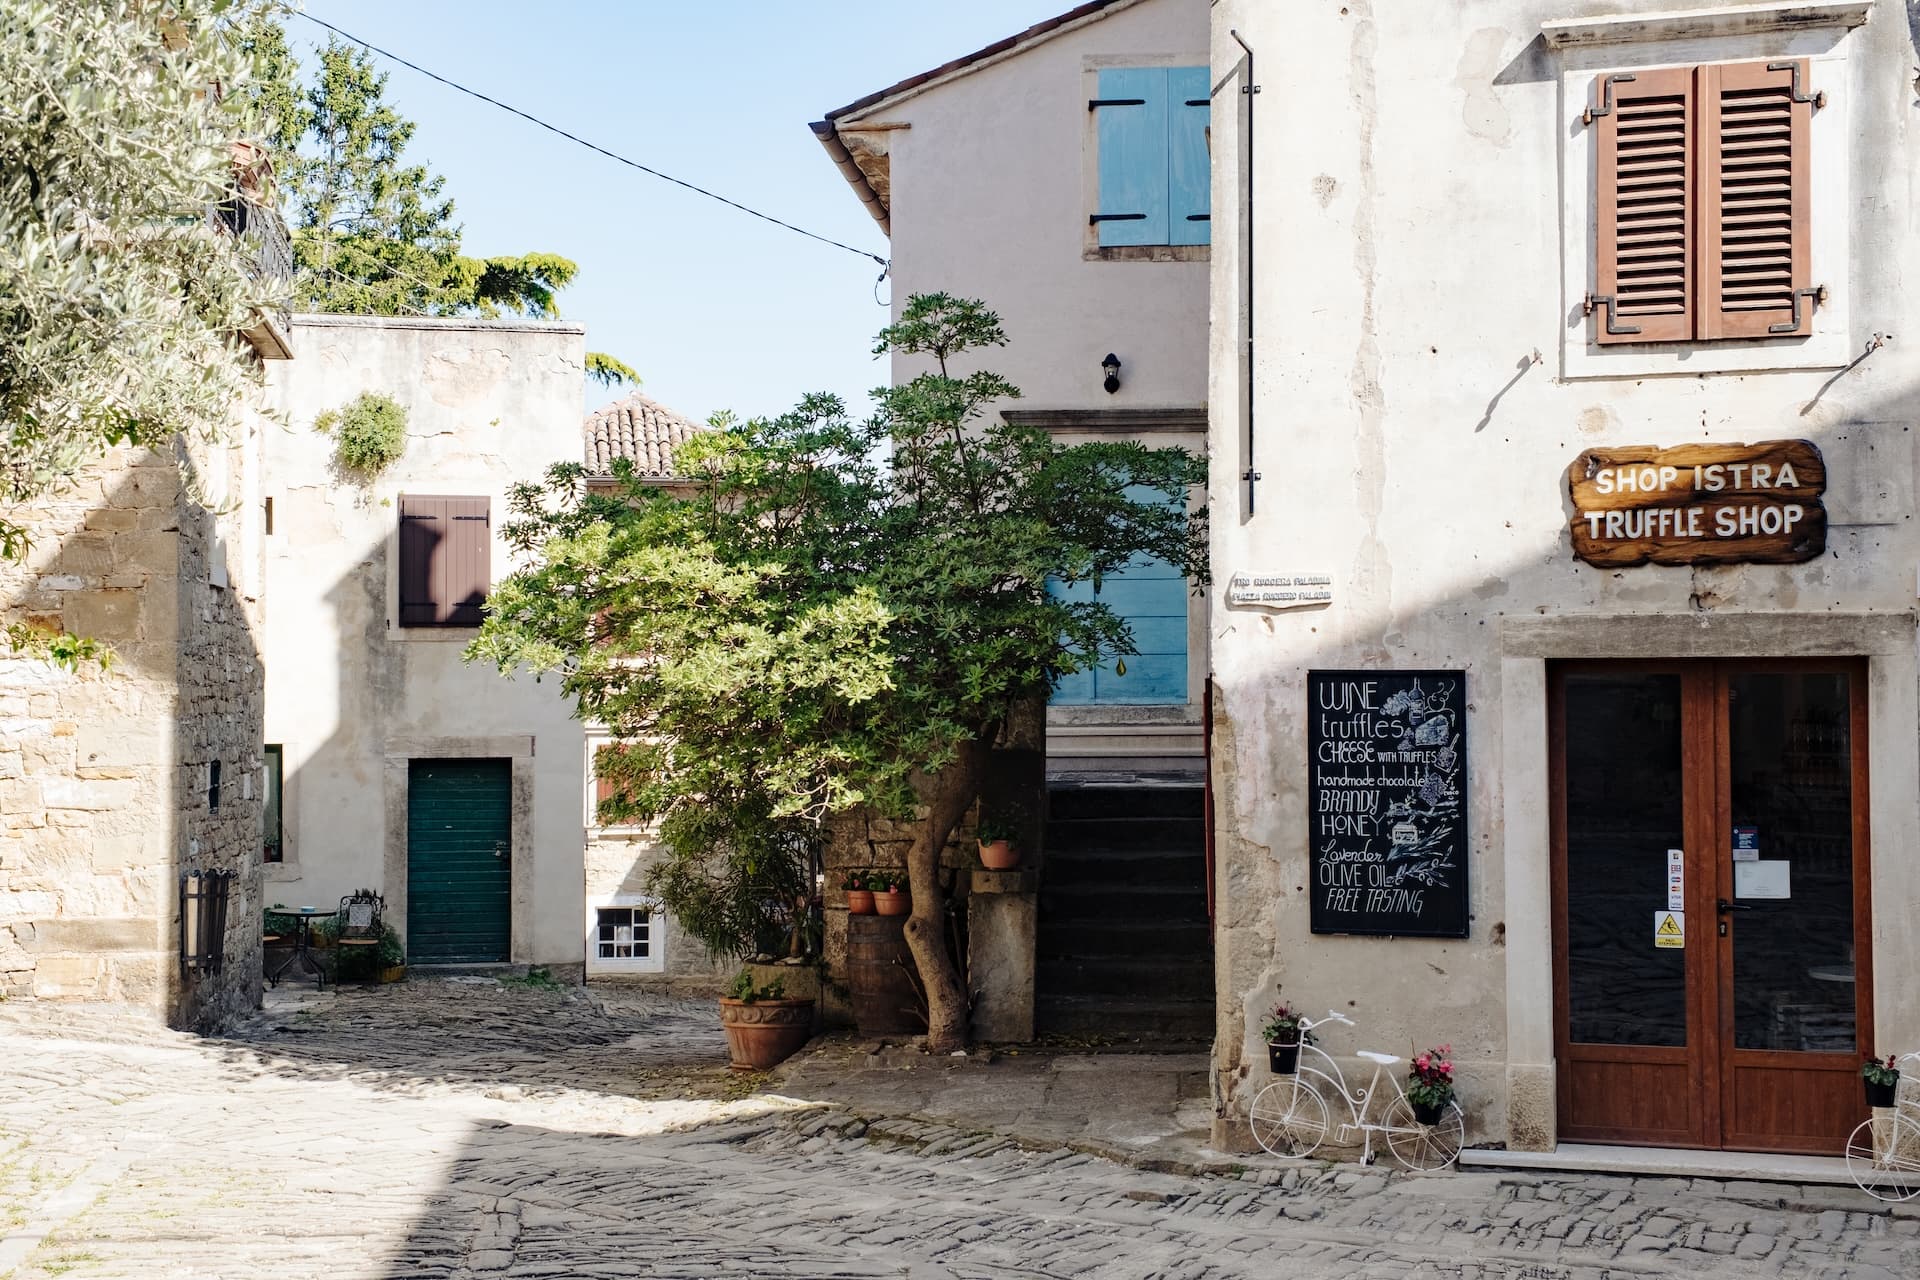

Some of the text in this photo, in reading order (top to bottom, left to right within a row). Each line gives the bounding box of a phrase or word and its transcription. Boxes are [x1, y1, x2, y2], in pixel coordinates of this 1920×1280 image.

[1596, 462, 1800, 495] SHOP ISTRA
[1583, 504, 1804, 539] TRUFFLE SHOP
[1320, 681, 1379, 714] WINE
[1322, 713, 1404, 738] truffles
[1318, 740, 1437, 764] CHEESE WITH TRUFFLES
[1317, 765, 1426, 787] handmade chocolate
[1318, 790, 1380, 815] BRANDY
[1322, 814, 1385, 836] HONEY
[1319, 839, 1384, 864] Lavender
[1320, 863, 1393, 887] OLIVE OIL
[1326, 888, 1424, 918] FREE TASTING
